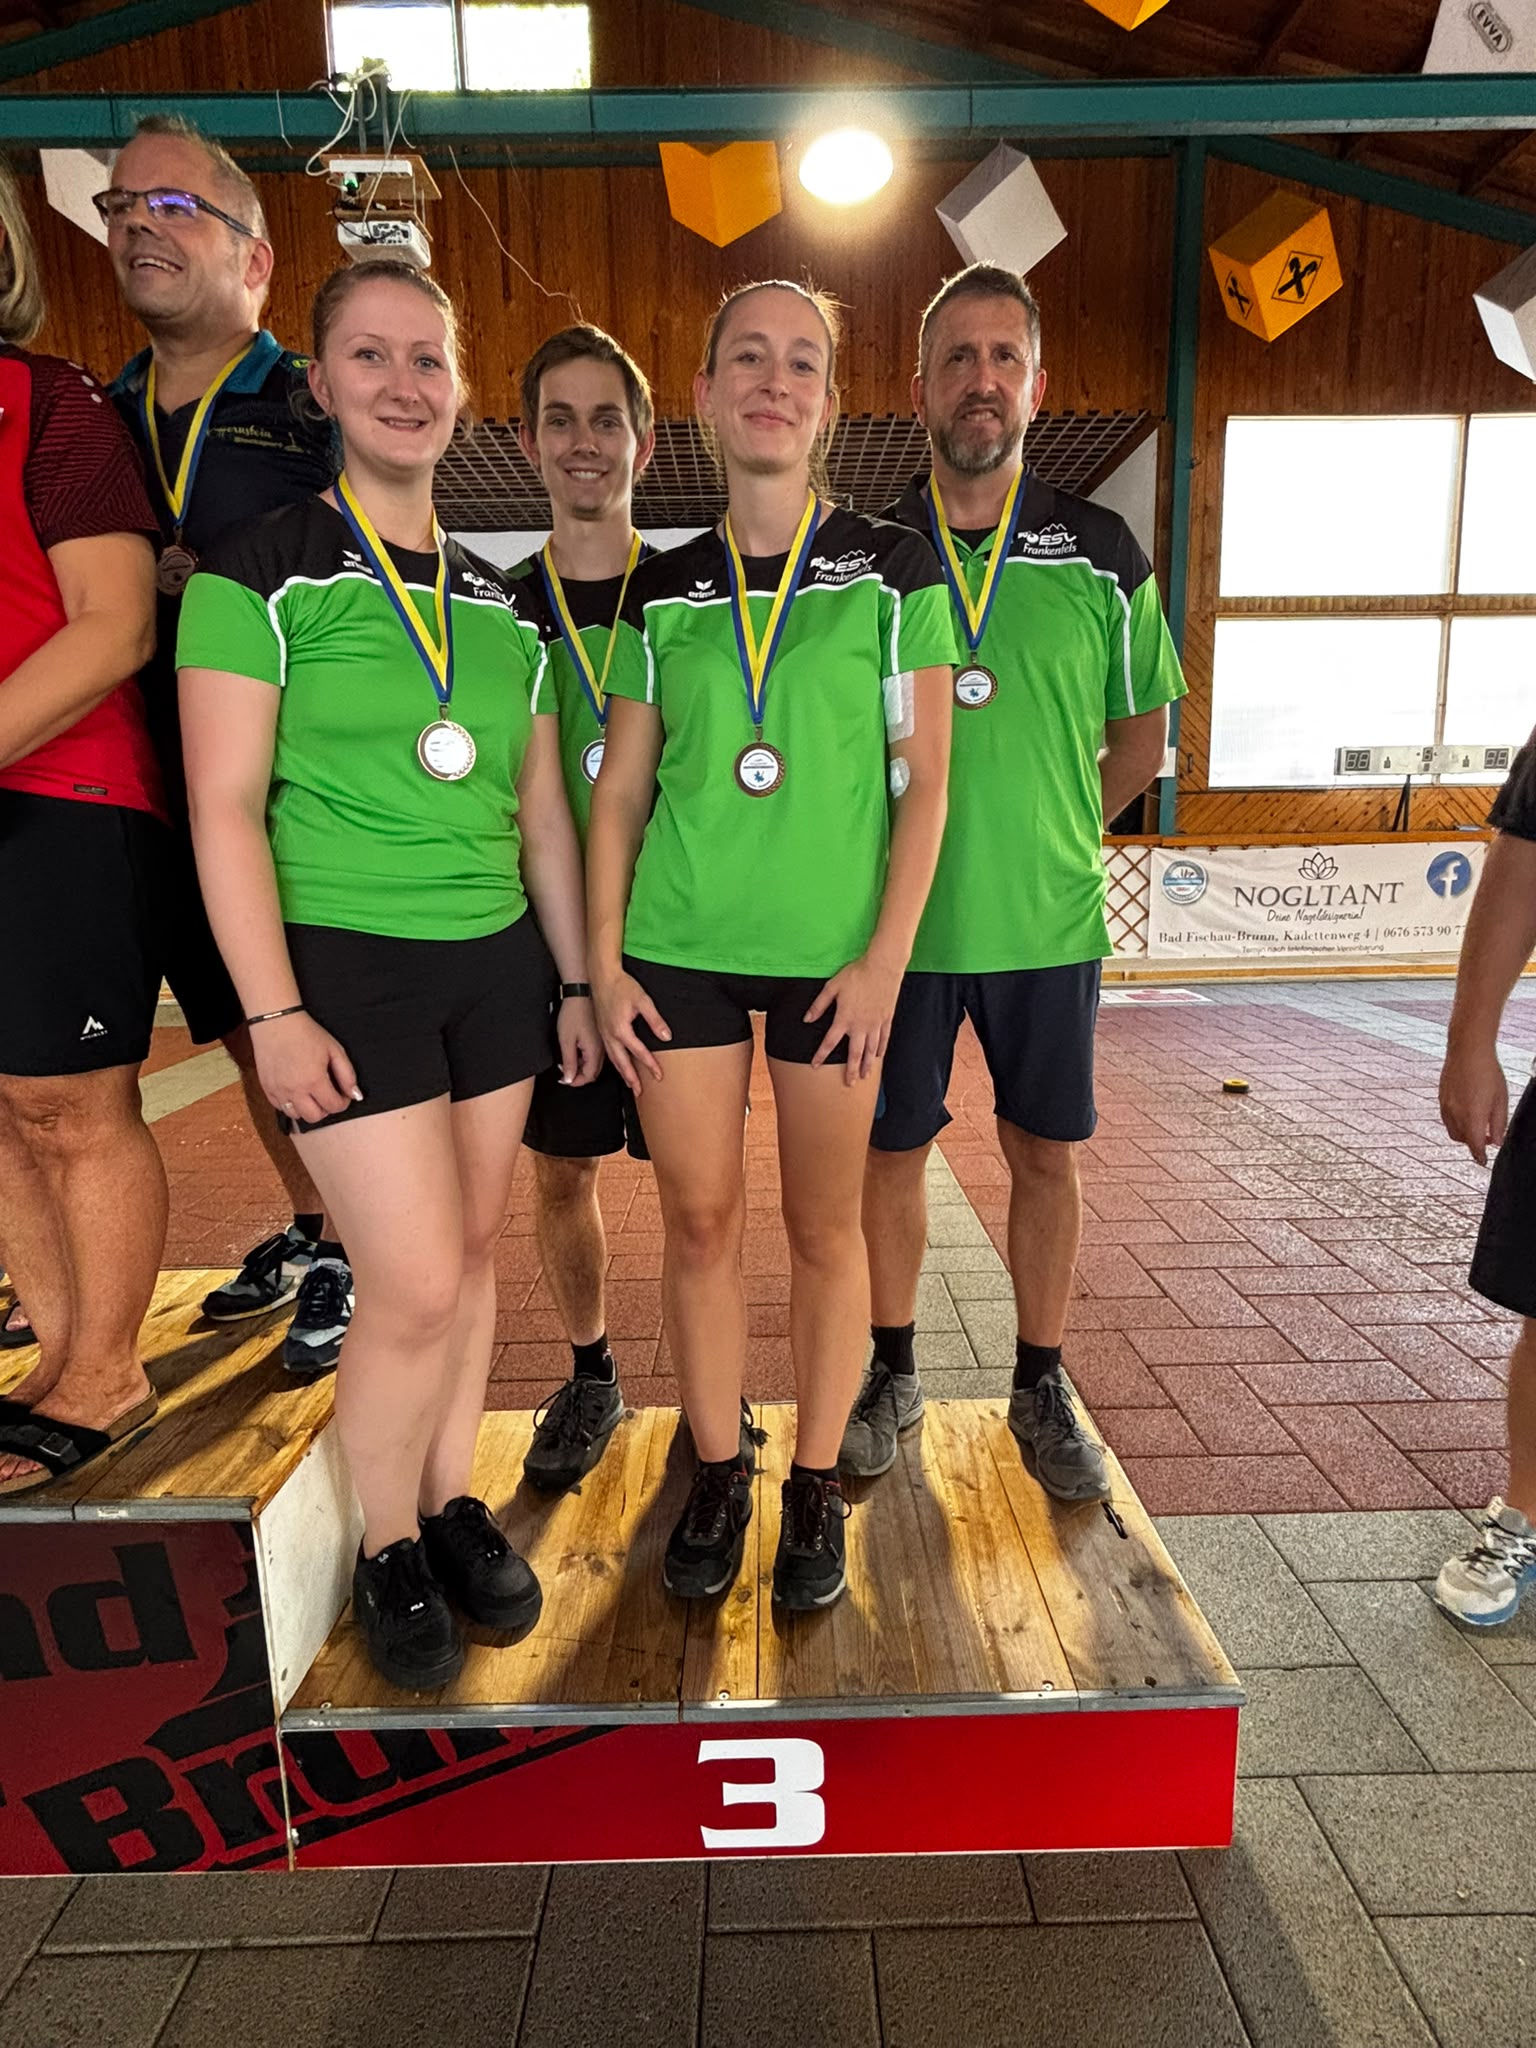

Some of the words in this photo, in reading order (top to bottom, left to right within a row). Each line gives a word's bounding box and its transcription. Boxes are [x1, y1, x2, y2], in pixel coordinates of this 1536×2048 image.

[1477, 9, 1503, 46] EVVA
[1039, 531, 1078, 546] ESV
[1022, 542, 1077, 556] Frankenfels
[833, 553, 877, 574] ESV
[688, 587, 717, 599] erima
[1233, 881, 1405, 908] NOGLTANT
[1267, 908, 1291, 923] Deine
[1294, 906, 1366, 926] Nageldesignerin!
[1159, 931, 1182, 943] Bad
[1186, 930, 1279, 943] Fischau-Brunn,
[1283, 929, 1361, 942] Kadettenweg
[1362, 928, 1371, 940] 4
[1383, 926, 1410, 939] 0676
[1413, 925, 1434, 938] 573
[1436, 925, 1452, 937] 90
[697, 1738, 826, 1849] 3
